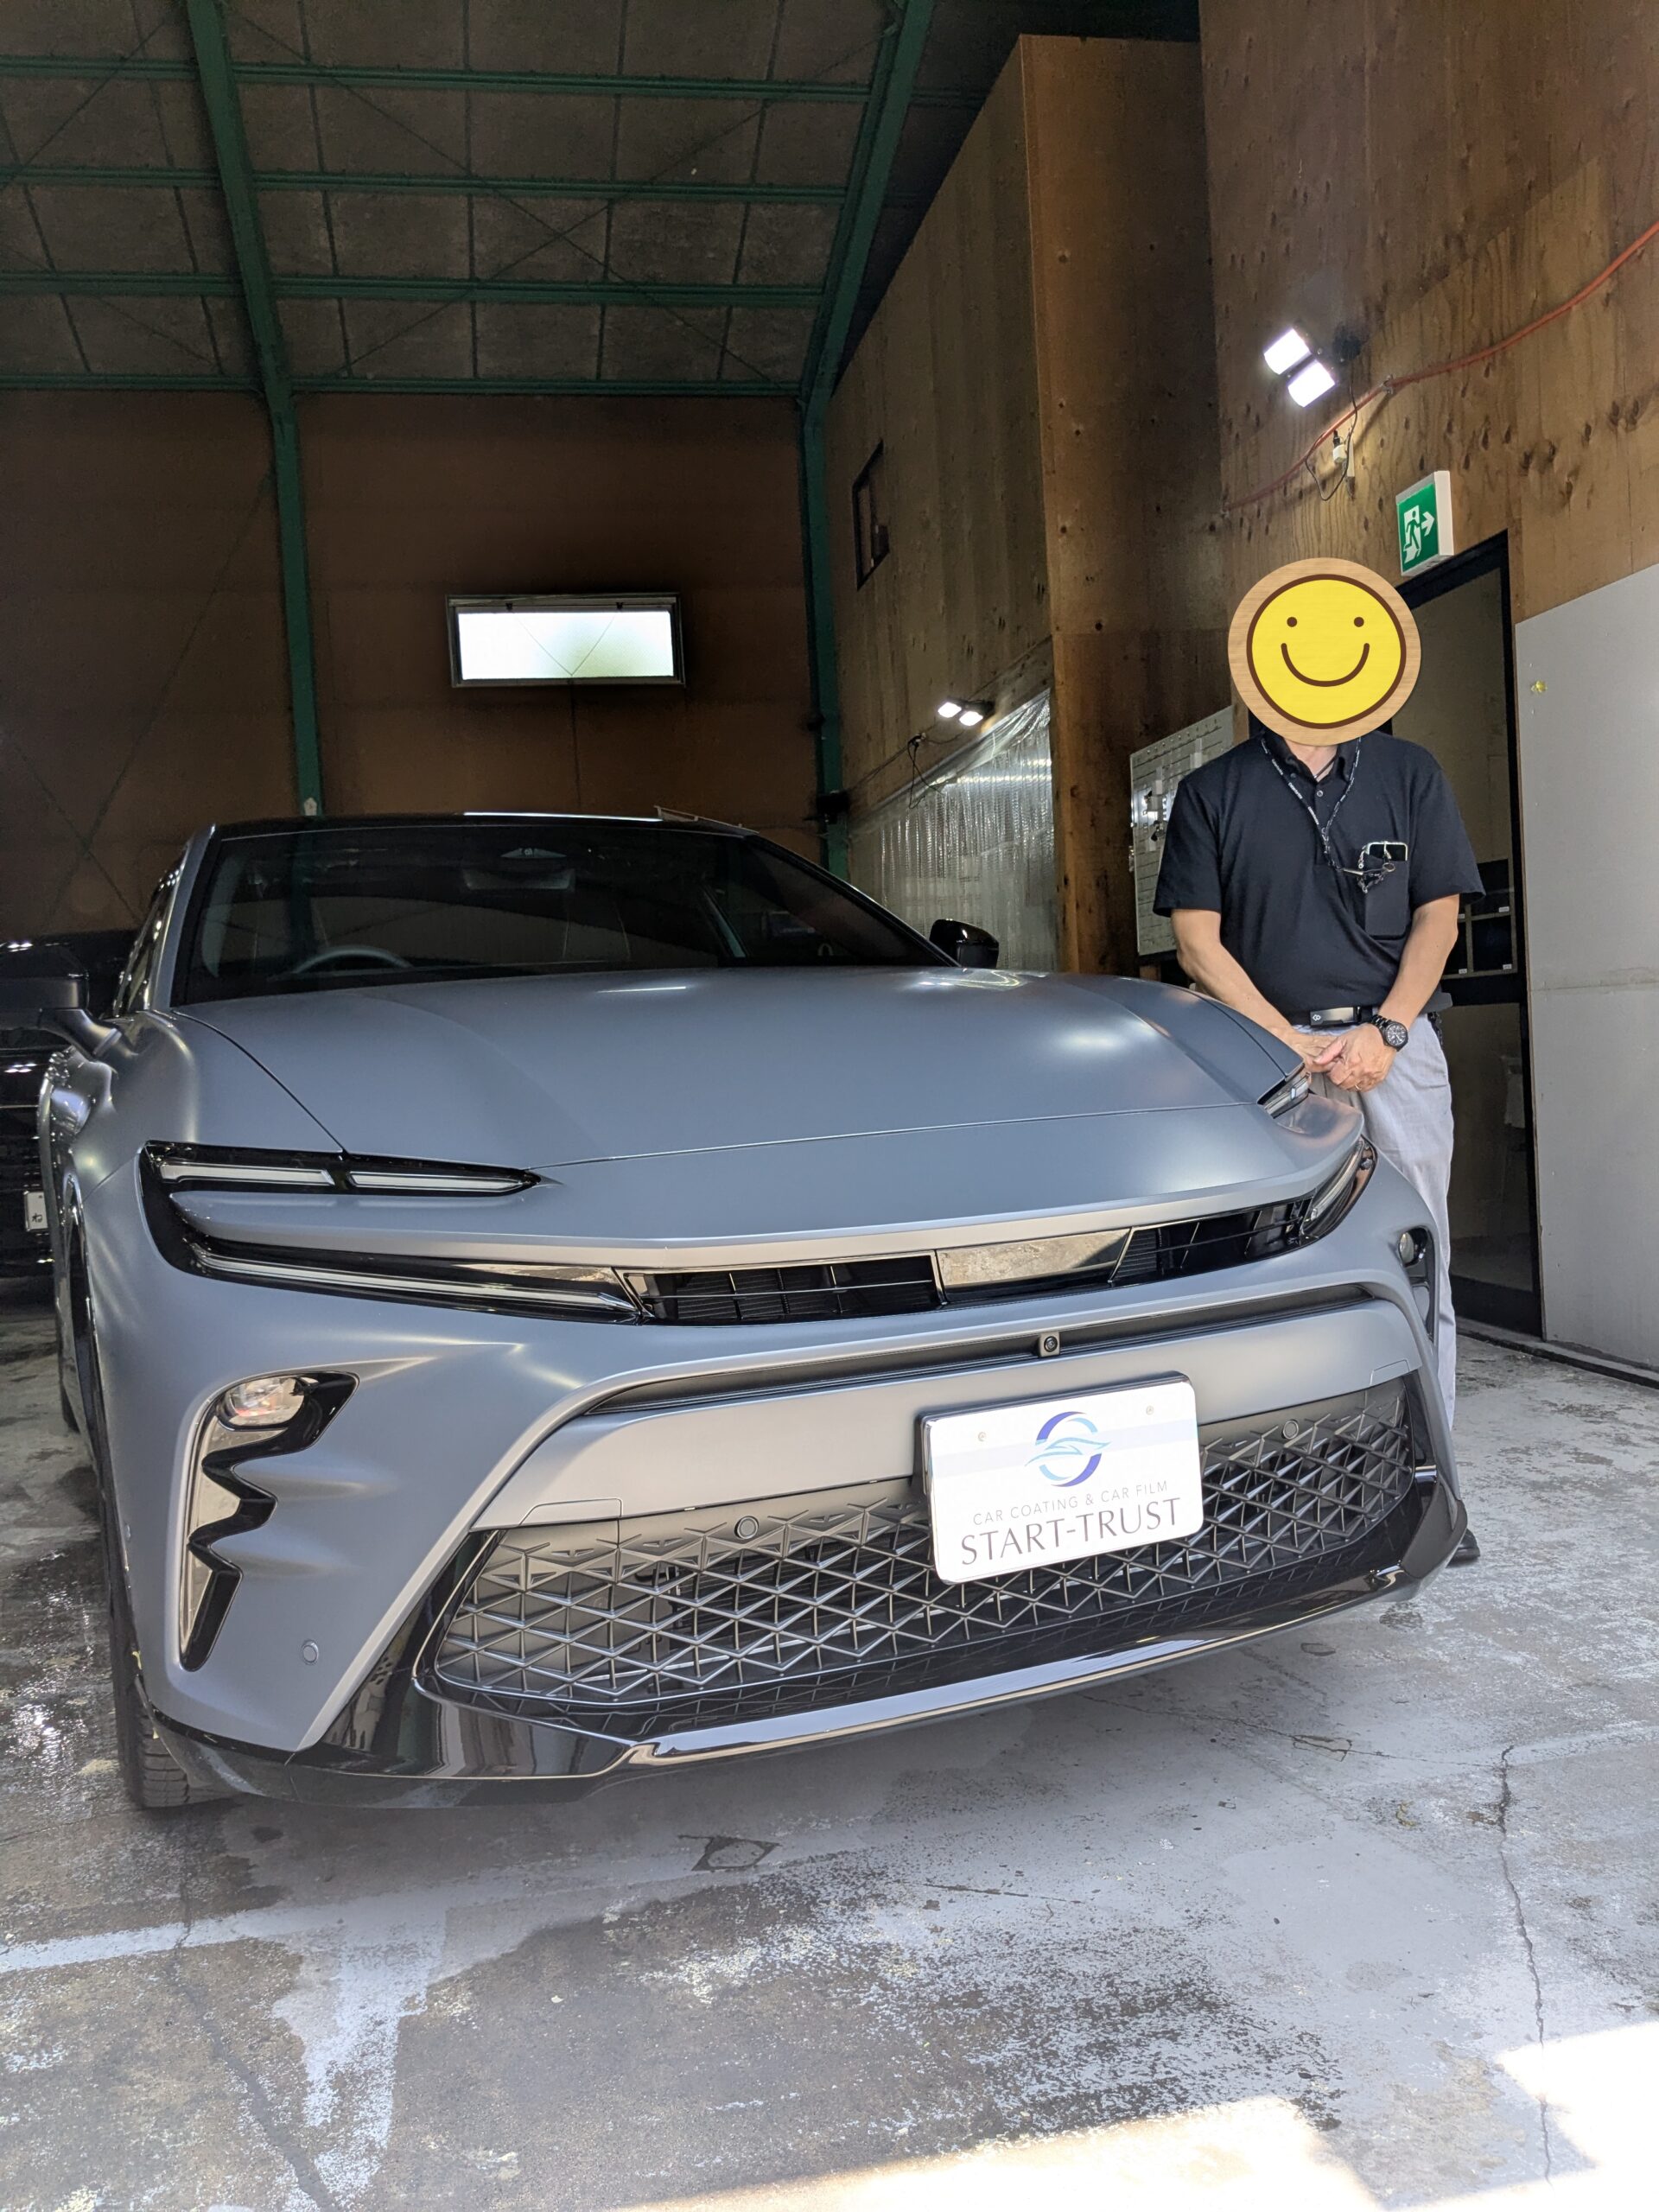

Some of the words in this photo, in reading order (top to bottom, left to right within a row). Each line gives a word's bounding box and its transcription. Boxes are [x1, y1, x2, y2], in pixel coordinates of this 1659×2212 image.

[961, 1497, 1181, 1565] START-TRUST
[973, 1510, 1003, 1526] CAR
[1010, 1496, 1078, 1519] COATING
[1085, 1493, 1095, 1505] &
[1101, 1487, 1129, 1503] CAR
[1135, 1480, 1167, 1497] FILM
